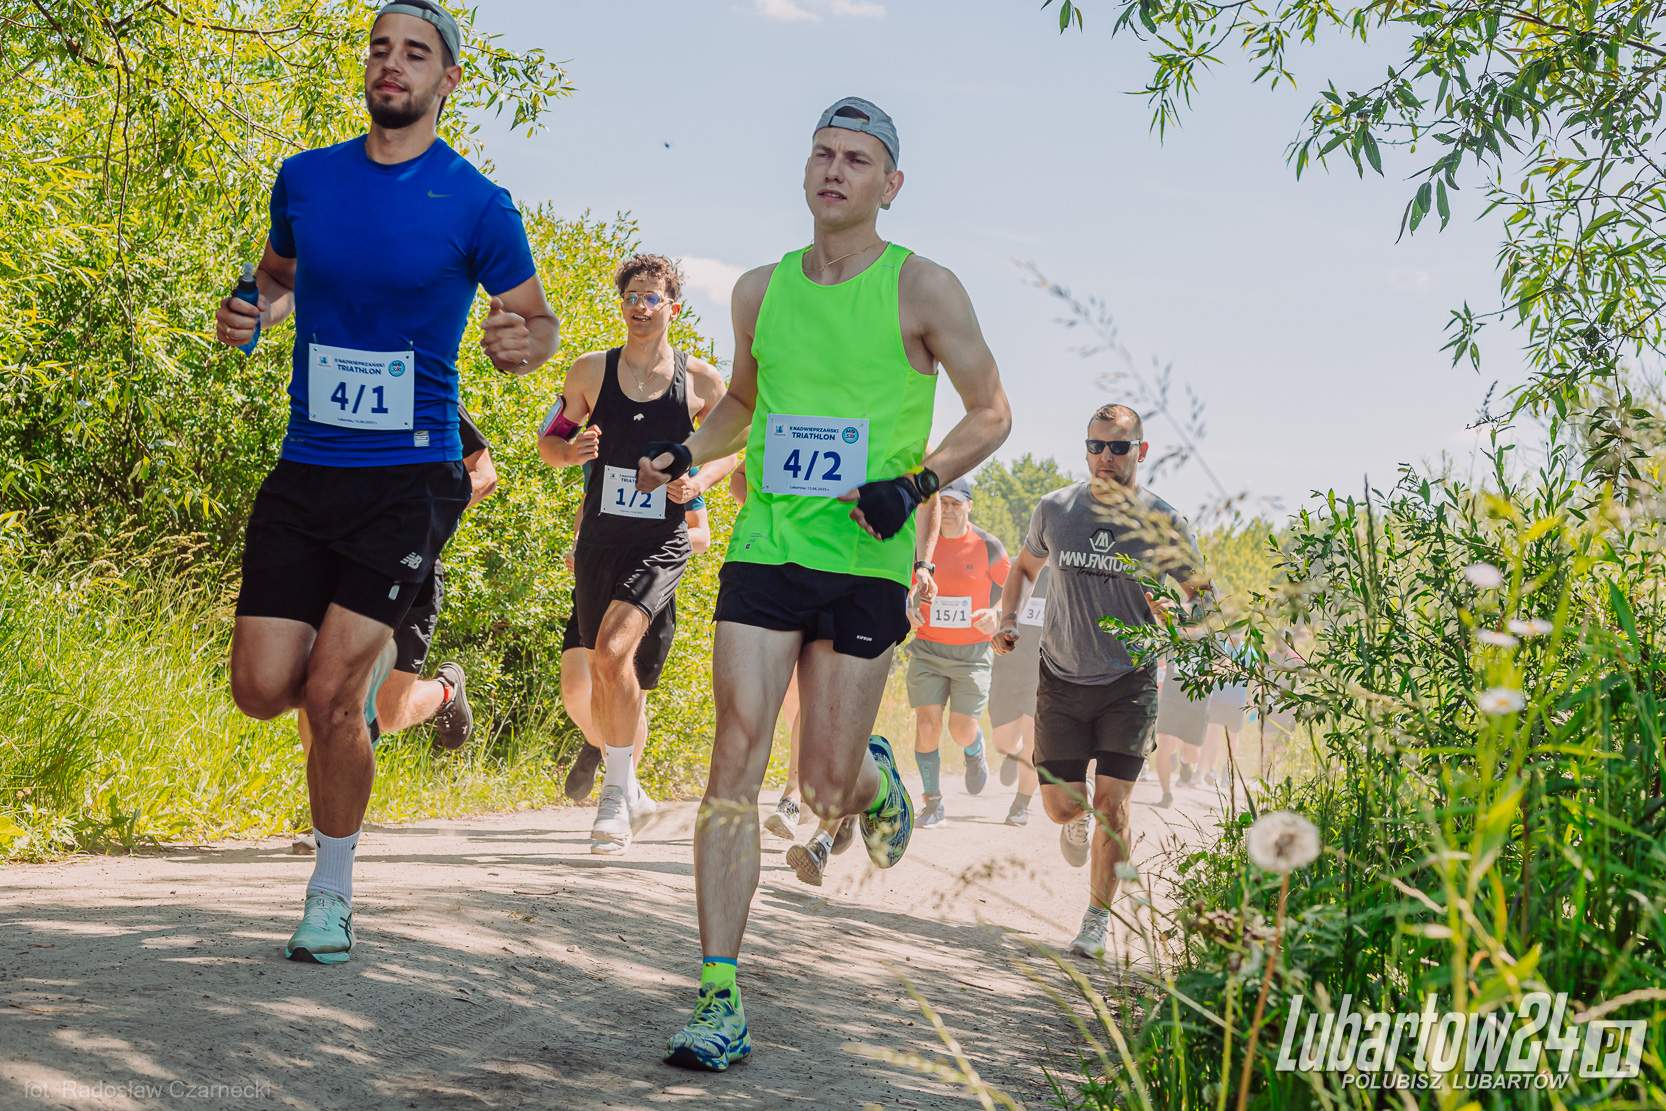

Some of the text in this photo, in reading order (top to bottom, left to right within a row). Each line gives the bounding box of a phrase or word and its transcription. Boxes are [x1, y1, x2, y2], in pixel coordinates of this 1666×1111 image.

[337, 364, 382, 375] TRIATHLON
[330, 382, 388, 414] 4/1
[792, 432, 836, 441] TRIATHLON
[783, 449, 842, 481] 4/2
[615, 488, 652, 508] 1/2
[935, 609, 967, 622] 15/1
[1026, 608, 1041, 620] 3/
